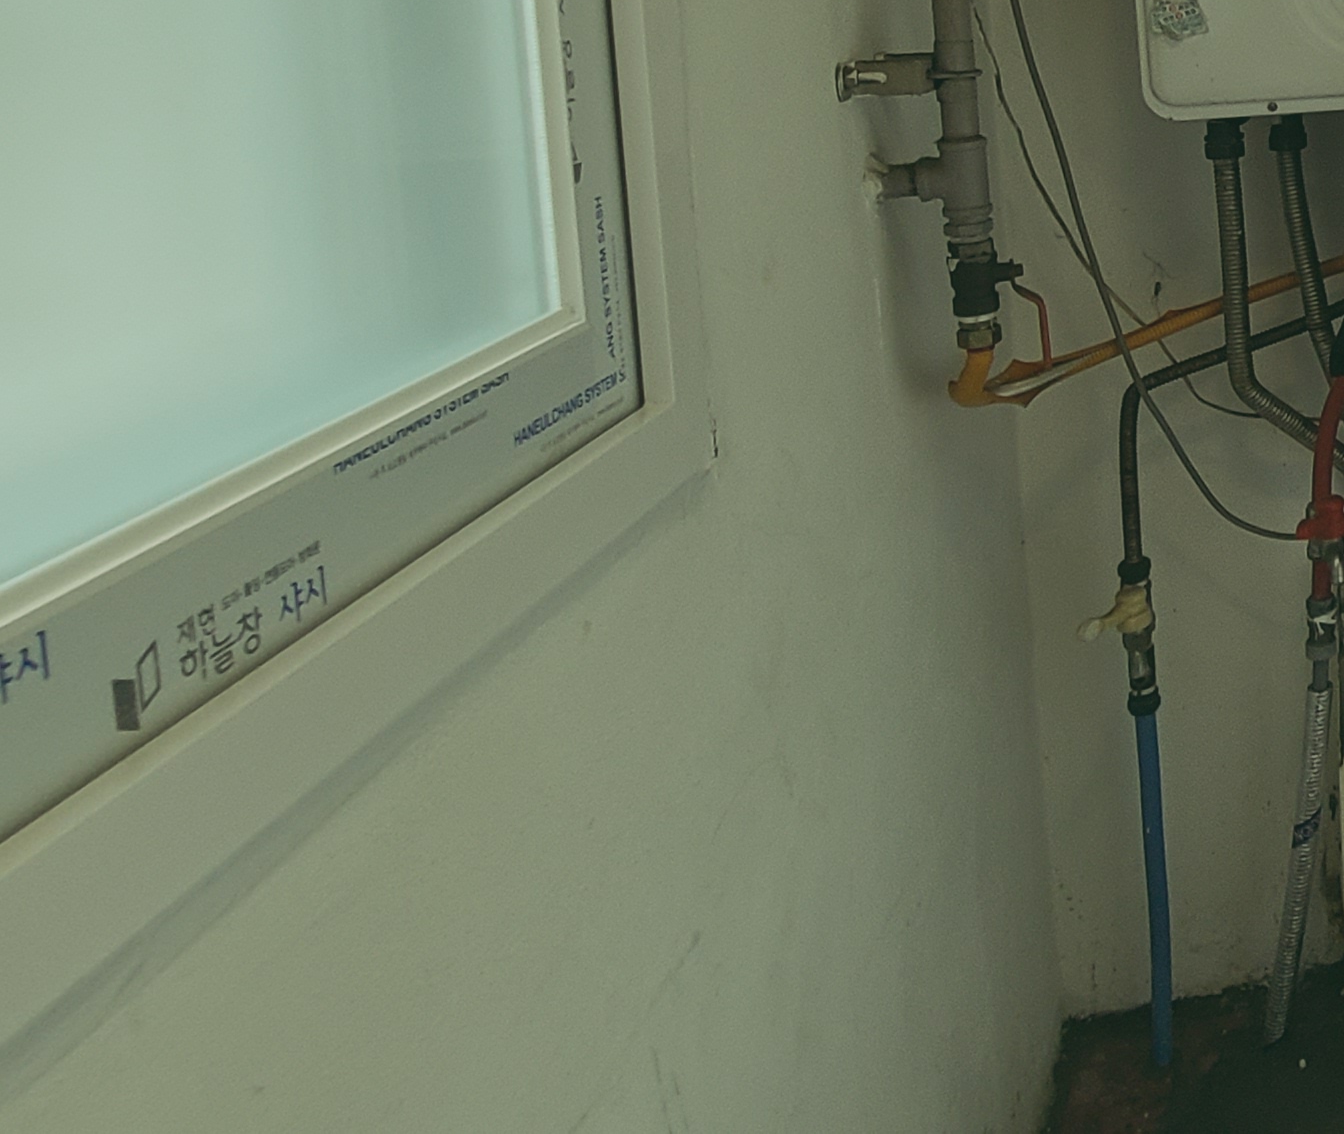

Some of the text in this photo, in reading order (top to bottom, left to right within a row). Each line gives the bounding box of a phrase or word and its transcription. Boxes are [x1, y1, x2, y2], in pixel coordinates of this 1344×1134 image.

[594, 195, 606, 244] SASH
[599, 247, 612, 318] SYSTEM
[513, 392, 584, 447] HANEULCHANG
[584, 371, 618, 404] SYSTEM
[179, 606, 263, 680] 하늘창
[279, 565, 329, 623] 샤시
